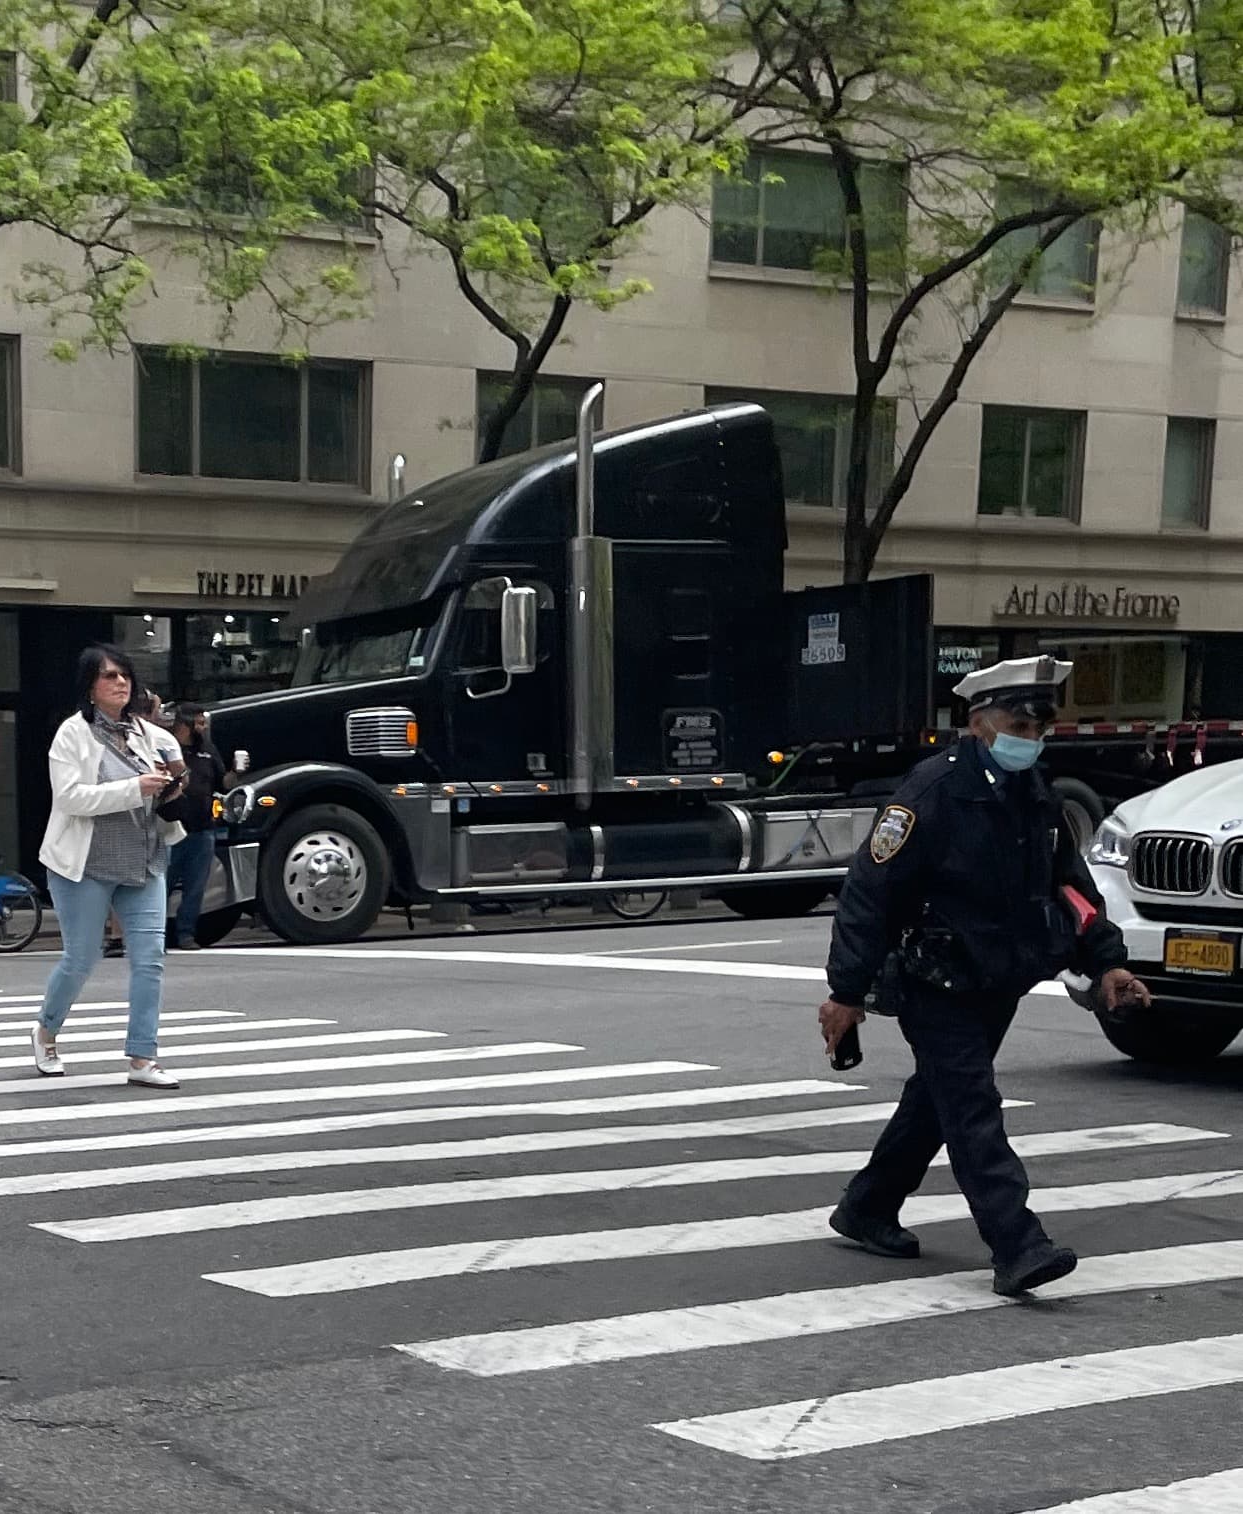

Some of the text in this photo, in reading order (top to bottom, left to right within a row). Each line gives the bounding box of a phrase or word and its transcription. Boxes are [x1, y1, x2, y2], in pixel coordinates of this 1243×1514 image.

[197, 571, 229, 597] THE
[236, 572, 265, 598] PET
[1004, 582, 1180, 619] Art of the Frame
